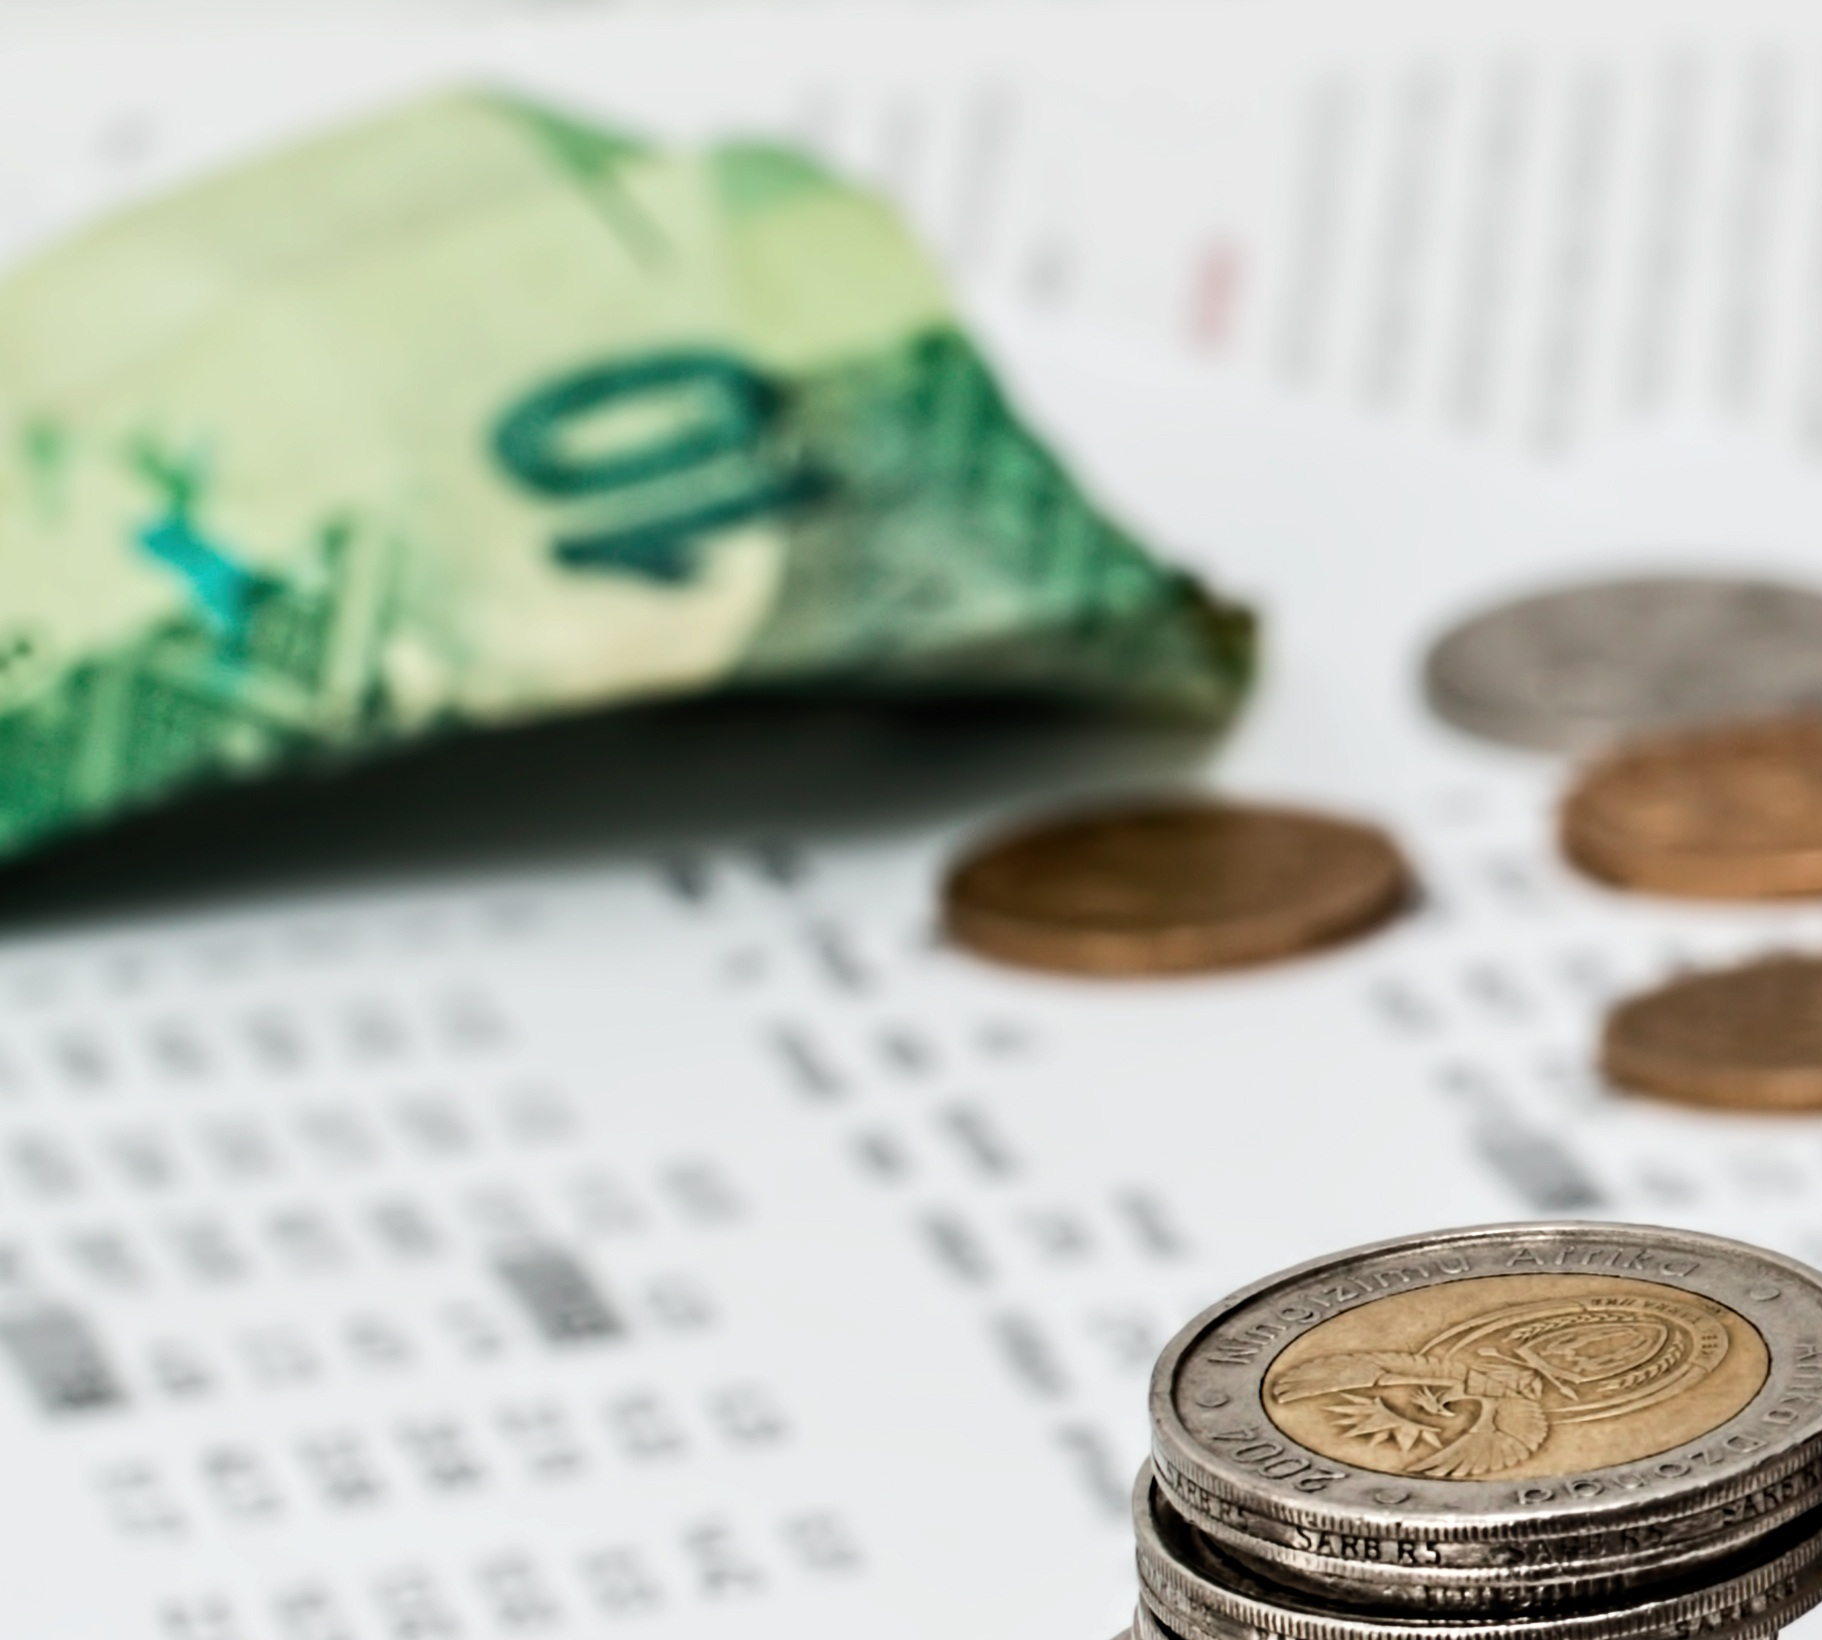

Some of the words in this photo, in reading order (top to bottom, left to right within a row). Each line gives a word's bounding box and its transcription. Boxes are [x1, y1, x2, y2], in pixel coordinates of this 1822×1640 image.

[493, 345, 843, 583] 10
[1208, 1254, 1470, 1366] Ningizimu
[1505, 1244, 1700, 1279] Afrika
[1207, 1426, 1350, 1494] 2004
[1293, 1526, 1382, 1561] SARB
[1397, 1538, 1442, 1566] R5
